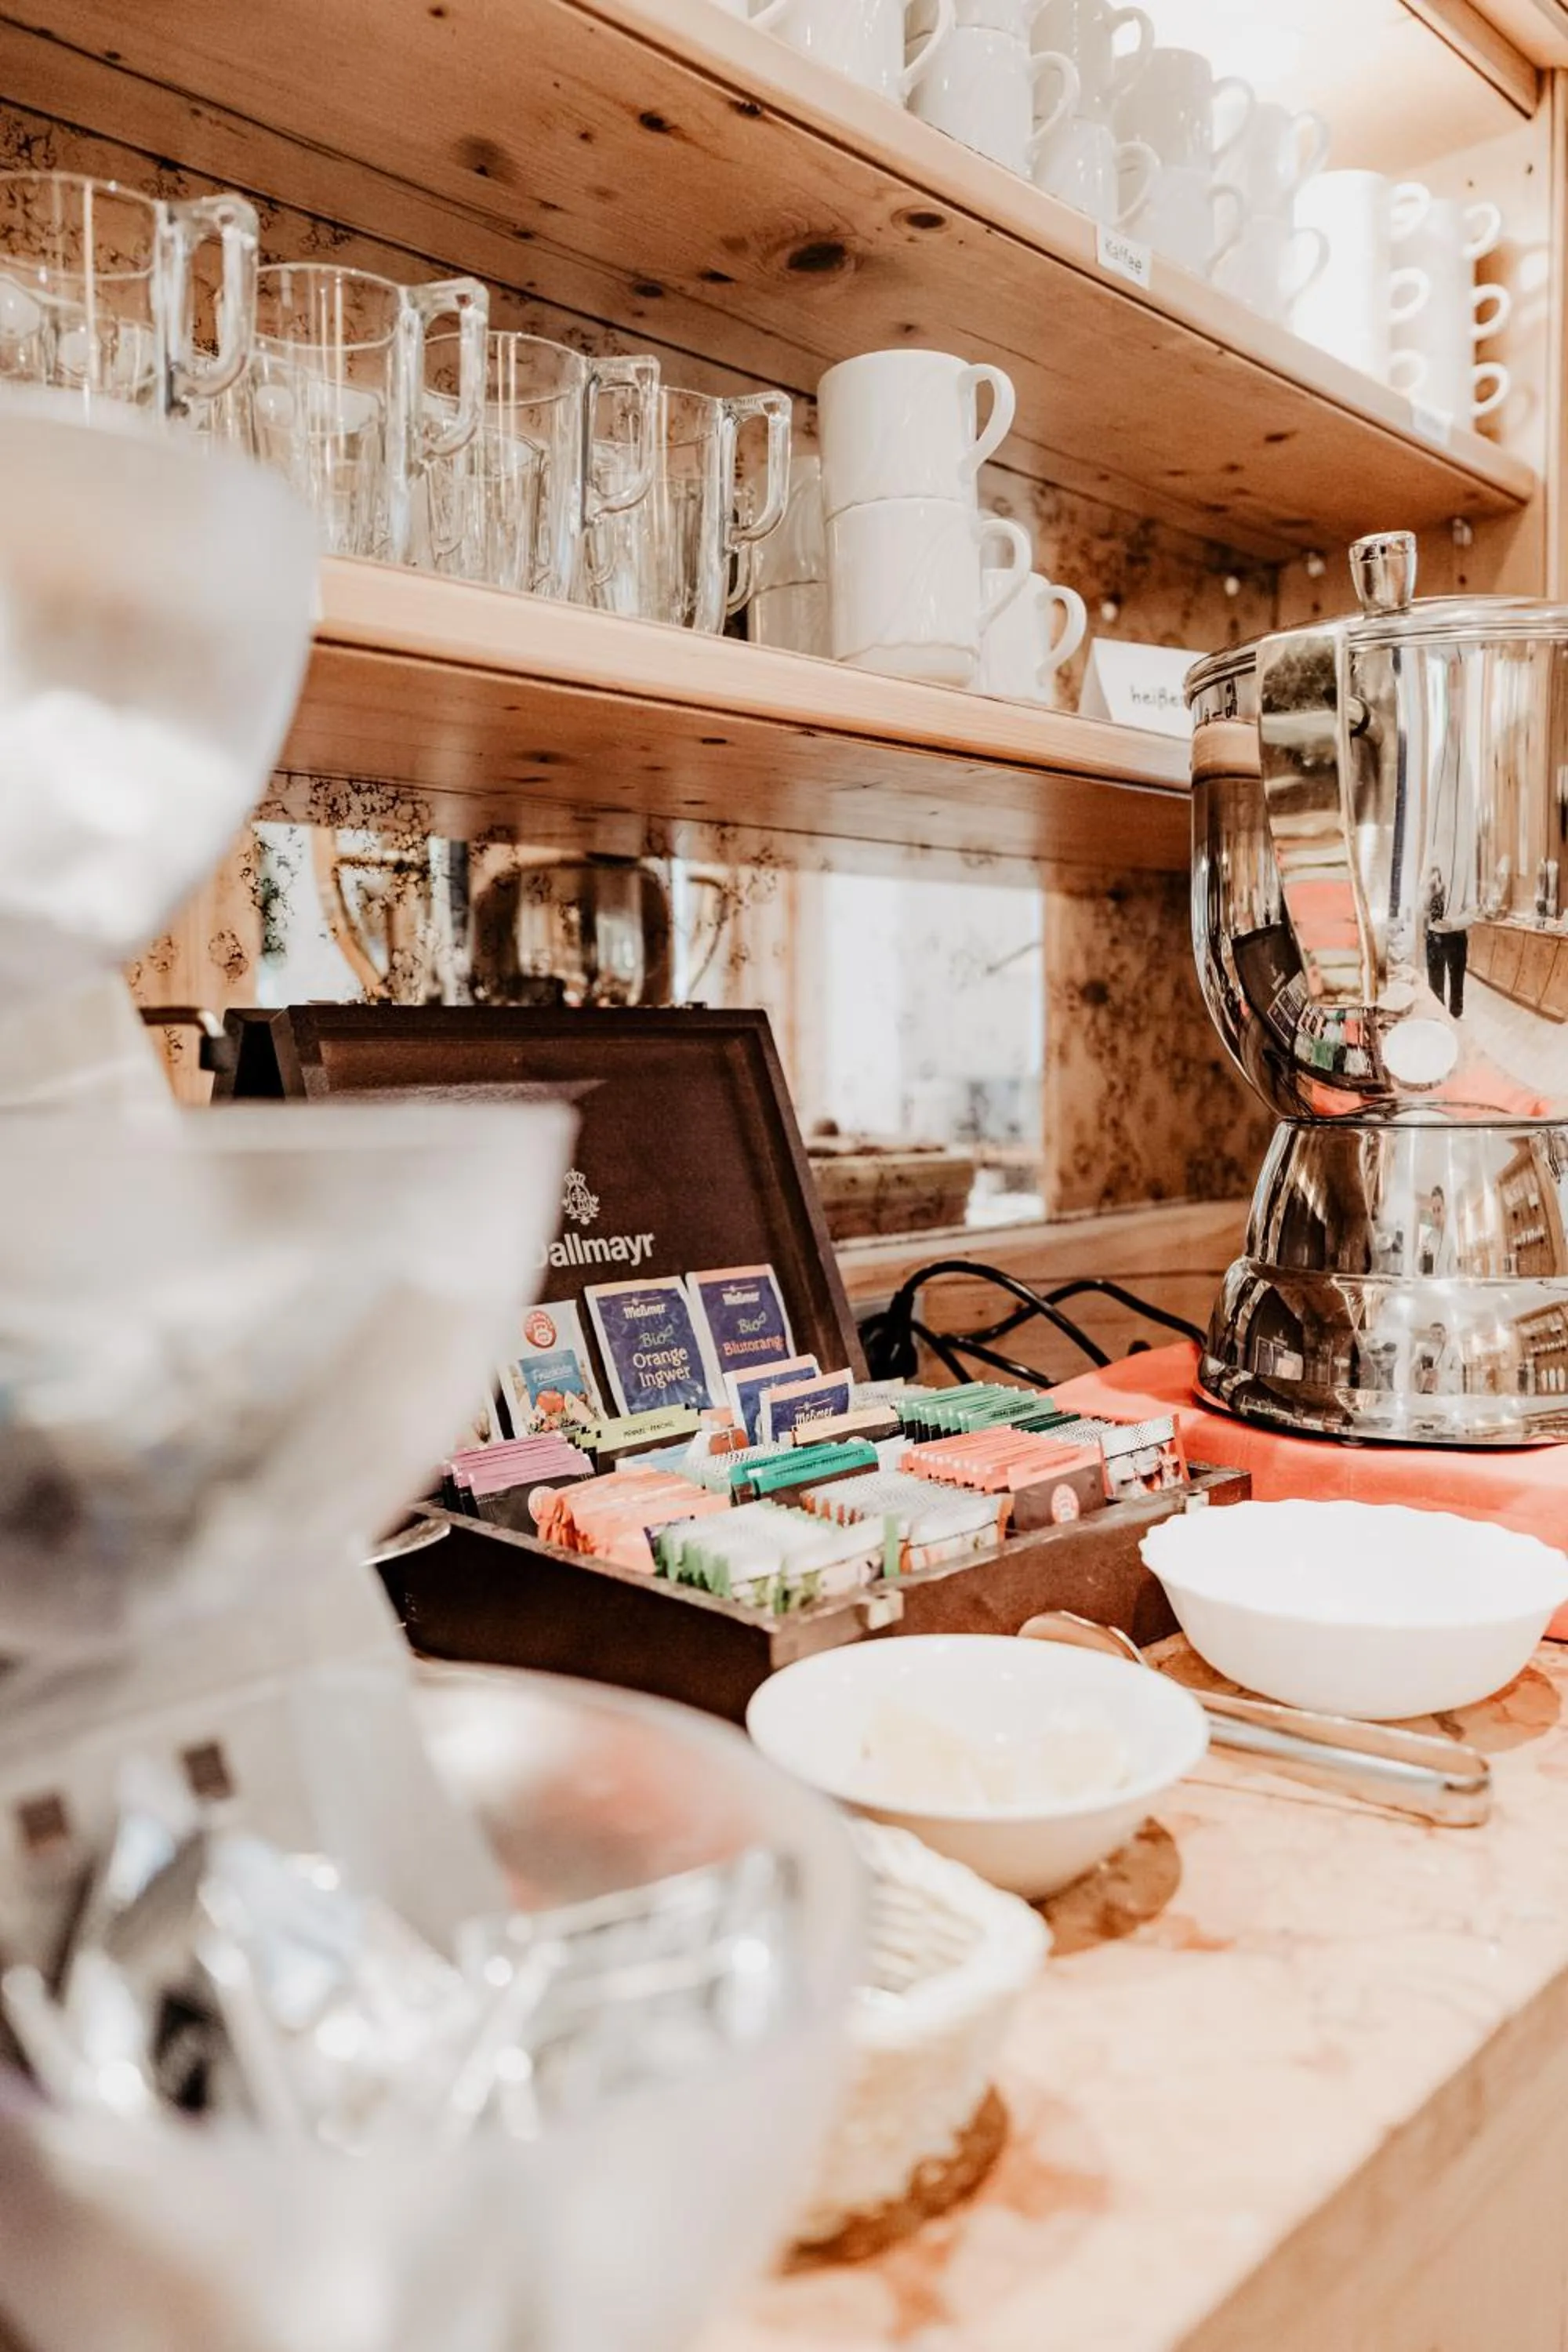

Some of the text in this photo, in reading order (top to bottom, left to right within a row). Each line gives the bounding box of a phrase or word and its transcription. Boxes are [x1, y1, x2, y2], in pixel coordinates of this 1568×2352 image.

[1130, 684, 1183, 711] heiße
[633, 1348, 688, 1368] Orange
[639, 1366, 691, 1388] Ingwer
